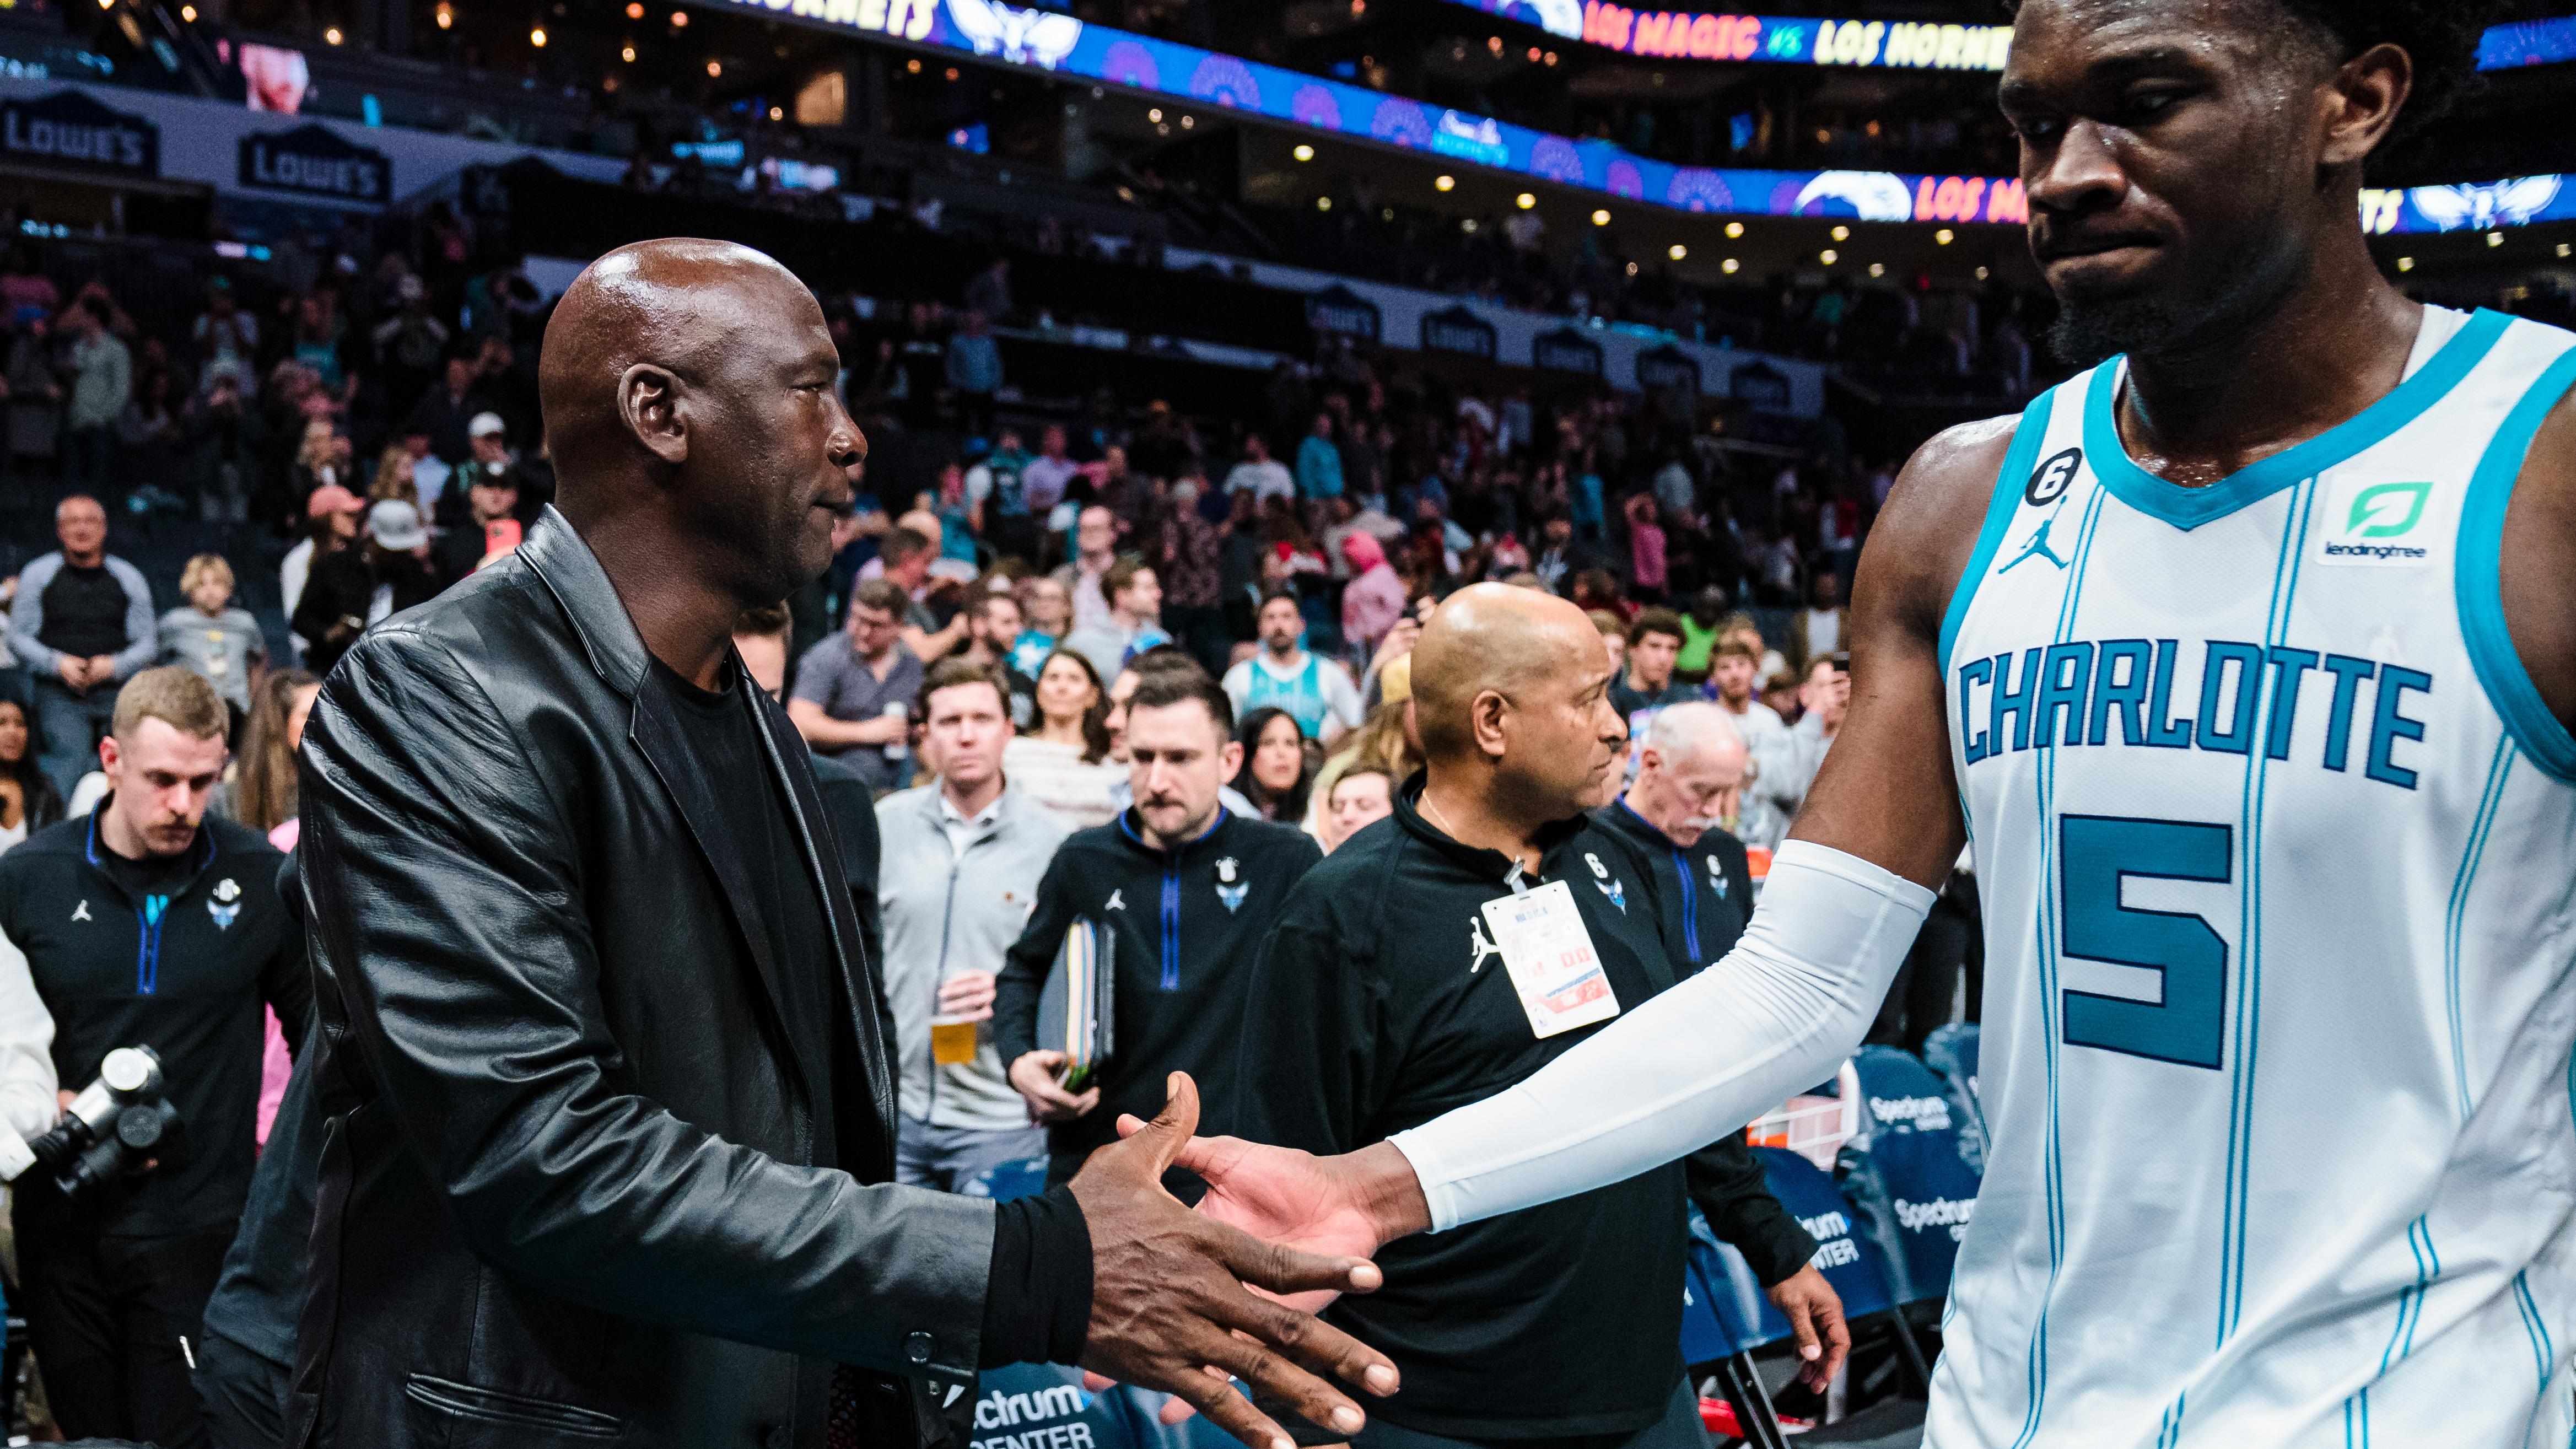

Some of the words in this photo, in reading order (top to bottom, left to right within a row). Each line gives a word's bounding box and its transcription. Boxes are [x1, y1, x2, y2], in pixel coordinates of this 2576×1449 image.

[729, 0, 940, 41] NETS
[1582, 0, 1634, 51] LOS
[1633, 11, 1763, 61] MAGIC
[1813, 20, 1885, 67] LOS
[1884, 21, 2016, 71] HORNE
[4, 109, 144, 165] LOWE'S
[253, 141, 378, 196] LOWE'S
[1914, 176, 1986, 223] LOS
[2033, 455, 2075, 500] 6
[2325, 541, 2427, 560] lendingtree
[1959, 638, 2433, 791] CHARLOTTE
[1584, 852, 1609, 879] 6
[2059, 812, 2233, 1071] 5
[1894, 1196, 1977, 1235] Spectru
[1809, 1238, 1860, 1270] NTER
[973, 1385, 1085, 1430] ctrum
